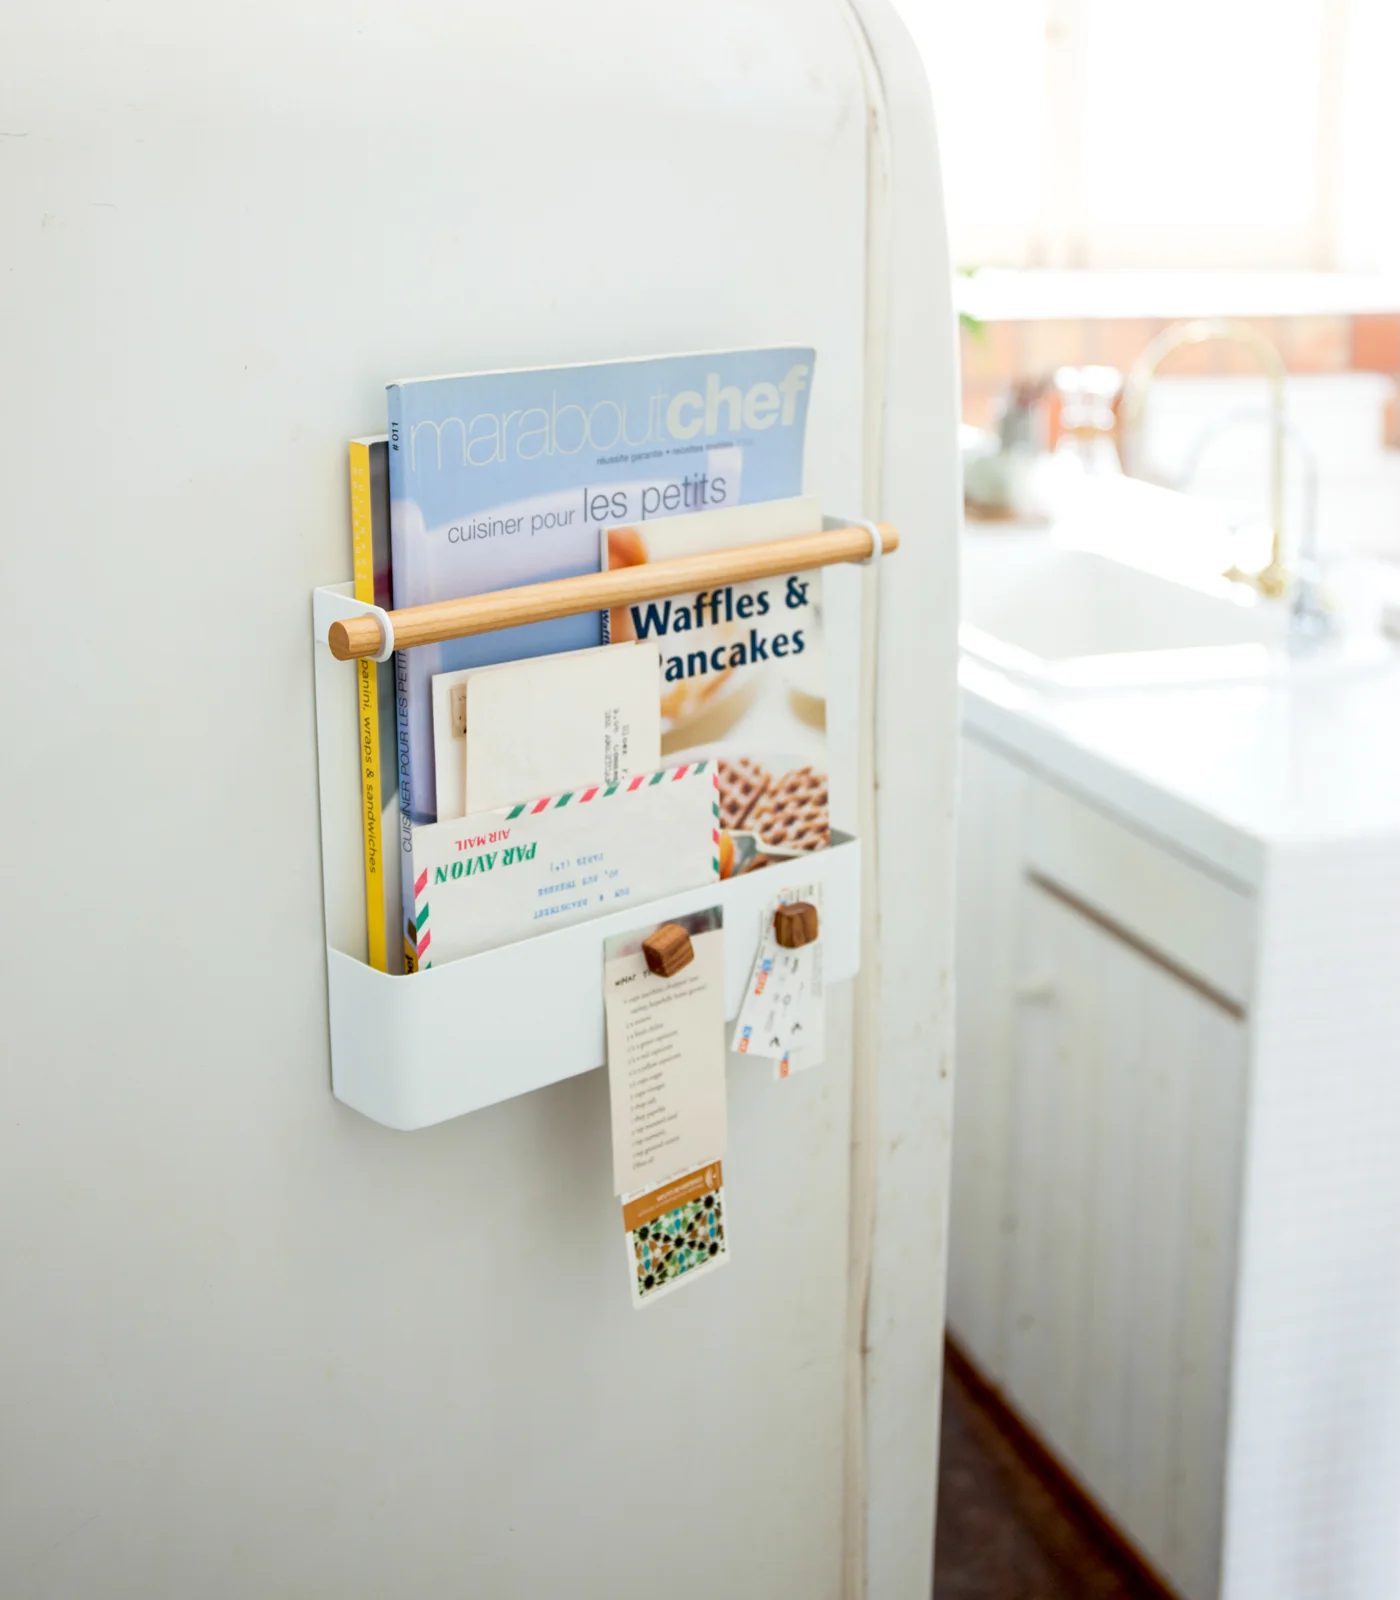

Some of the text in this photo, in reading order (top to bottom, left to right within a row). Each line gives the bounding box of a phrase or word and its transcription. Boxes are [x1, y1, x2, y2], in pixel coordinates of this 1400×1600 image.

[448, 472, 728, 544] cuisiner pour les petits
[630, 575, 810, 640] Waffles &
[659, 628, 806, 682] ancakes
[360, 658, 378, 873] panini, wraps & sandwiches
[397, 648, 413, 853] CUISINER POUR LES PETIT
[434, 842, 538, 885] PAR AVION
[455, 828, 511, 851] AIR MAIL
